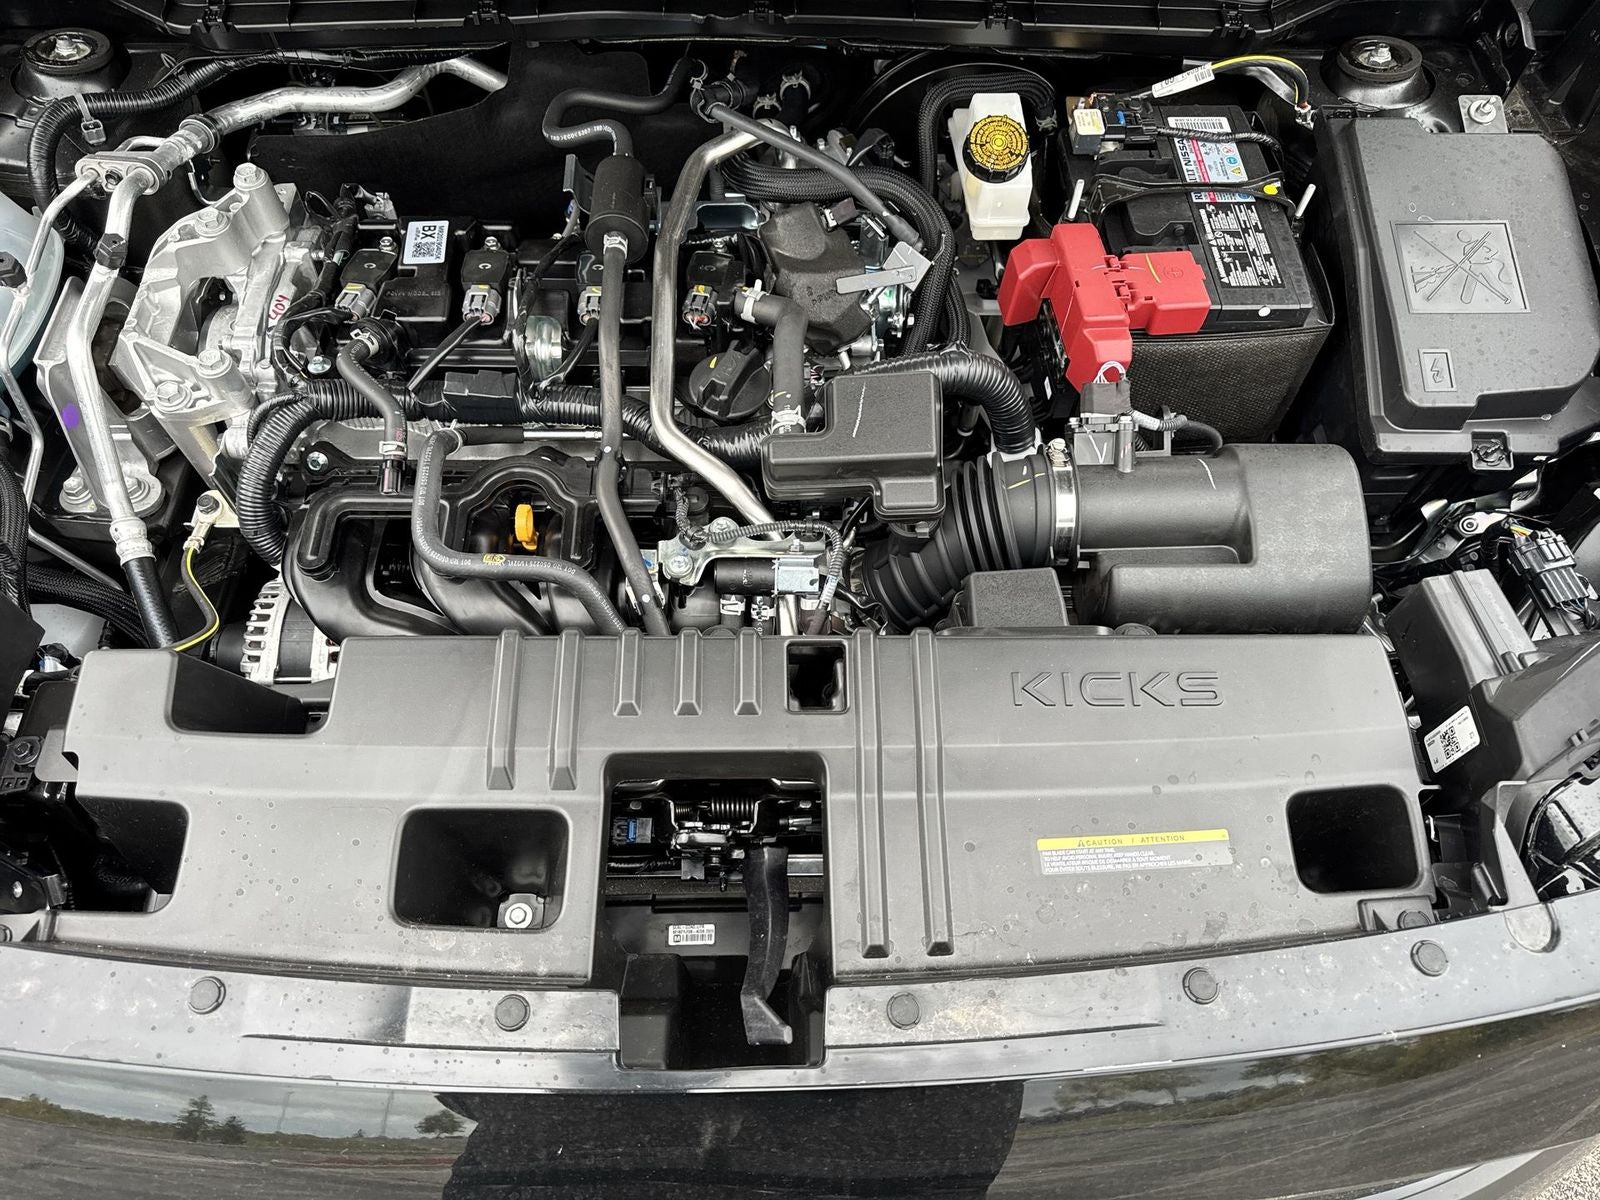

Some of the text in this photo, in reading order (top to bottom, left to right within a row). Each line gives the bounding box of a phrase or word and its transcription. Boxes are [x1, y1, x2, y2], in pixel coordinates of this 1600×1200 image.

[1177, 138, 1192, 166] NISSA
[420, 225, 436, 239] BX
[1011, 672, 1224, 707] KICKS
[1140, 835, 1185, 843] ATTENTION
